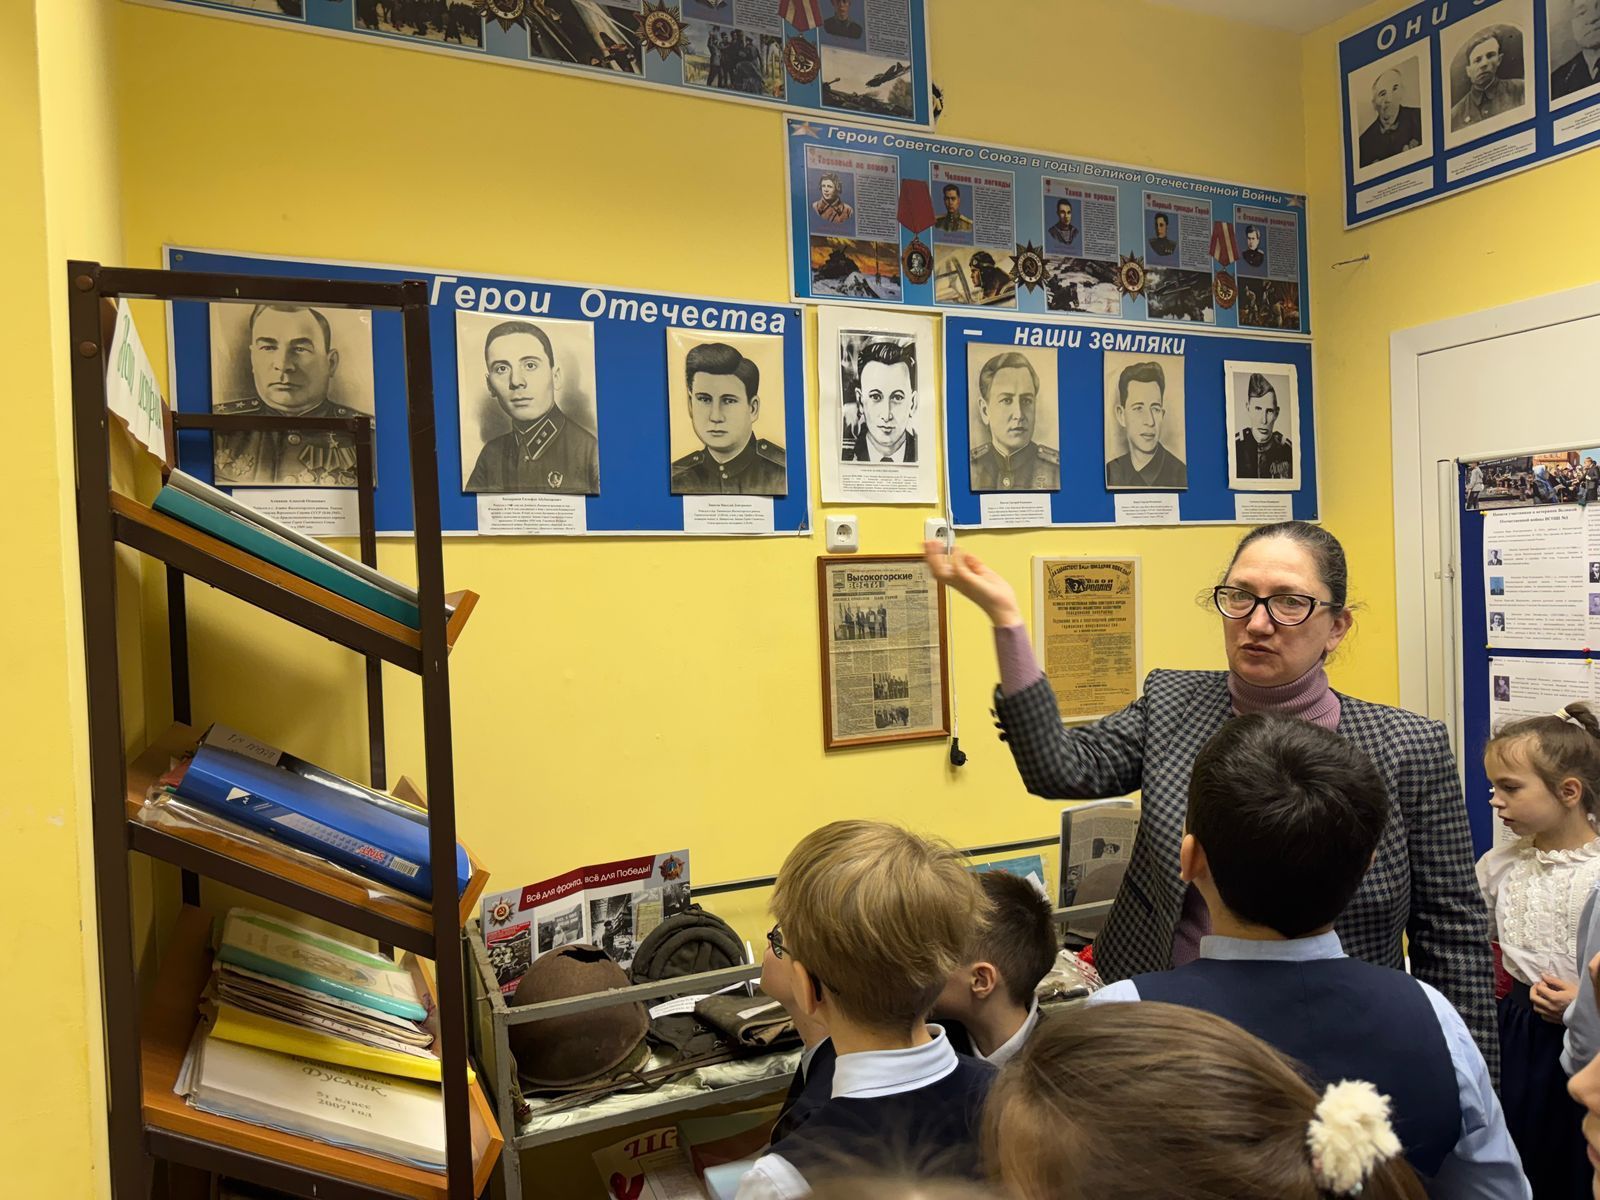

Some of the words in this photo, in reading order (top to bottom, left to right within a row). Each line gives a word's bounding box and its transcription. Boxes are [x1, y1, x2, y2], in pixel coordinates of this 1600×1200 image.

[827, 126, 878, 146] Герои
[883, 134, 974, 158] Советского
[979, 149, 1027, 166] Союза
[1031, 158, 1041, 168] в
[1044, 160, 1081, 174] годы
[1083, 163, 1142, 183] Великой
[1144, 173, 1239, 198] Отечественной
[1241, 187, 1283, 205] Войны
[430, 275, 552, 312] Герои
[580, 288, 785, 333] Отечества
[1014, 326, 1082, 348] наши
[1089, 331, 1186, 355] земляки
[847, 572, 913, 582] Высокогорские
[526, 893, 541, 903] Всё
[542, 888, 555, 900] для
[584, 874, 599, 883] всё
[600, 872, 615, 882] для
[616, 864, 651, 878] Победы!
[318, 1098, 346, 1112] 2007
